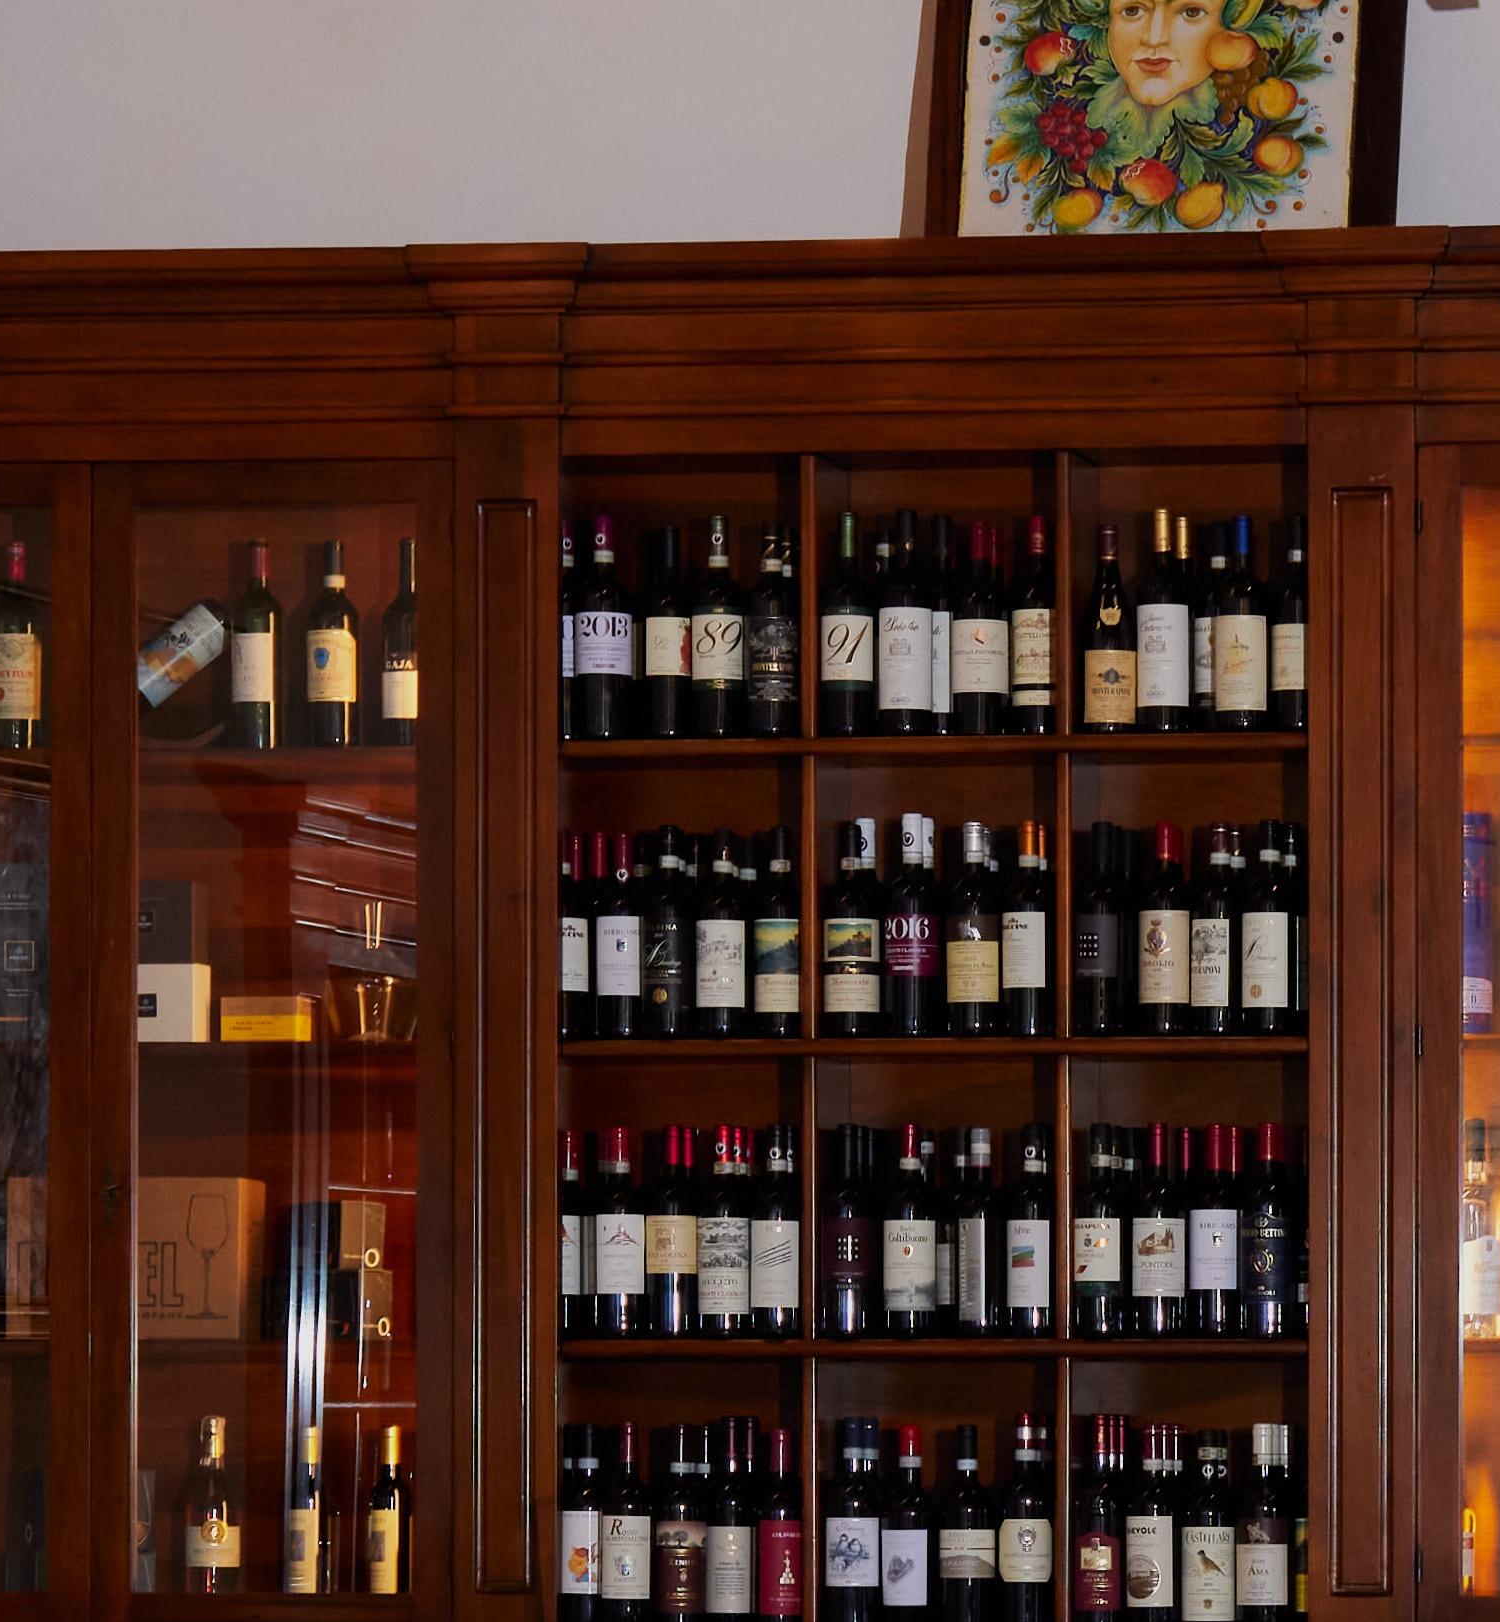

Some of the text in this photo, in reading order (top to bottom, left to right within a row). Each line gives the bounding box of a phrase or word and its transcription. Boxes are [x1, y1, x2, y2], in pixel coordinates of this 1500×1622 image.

[580, 615, 628, 638] 2013
[696, 619, 742, 656] 89
[827, 622, 869, 664] 91
[386, 660, 414, 670] GAJA
[884, 917, 929, 940] 2016
